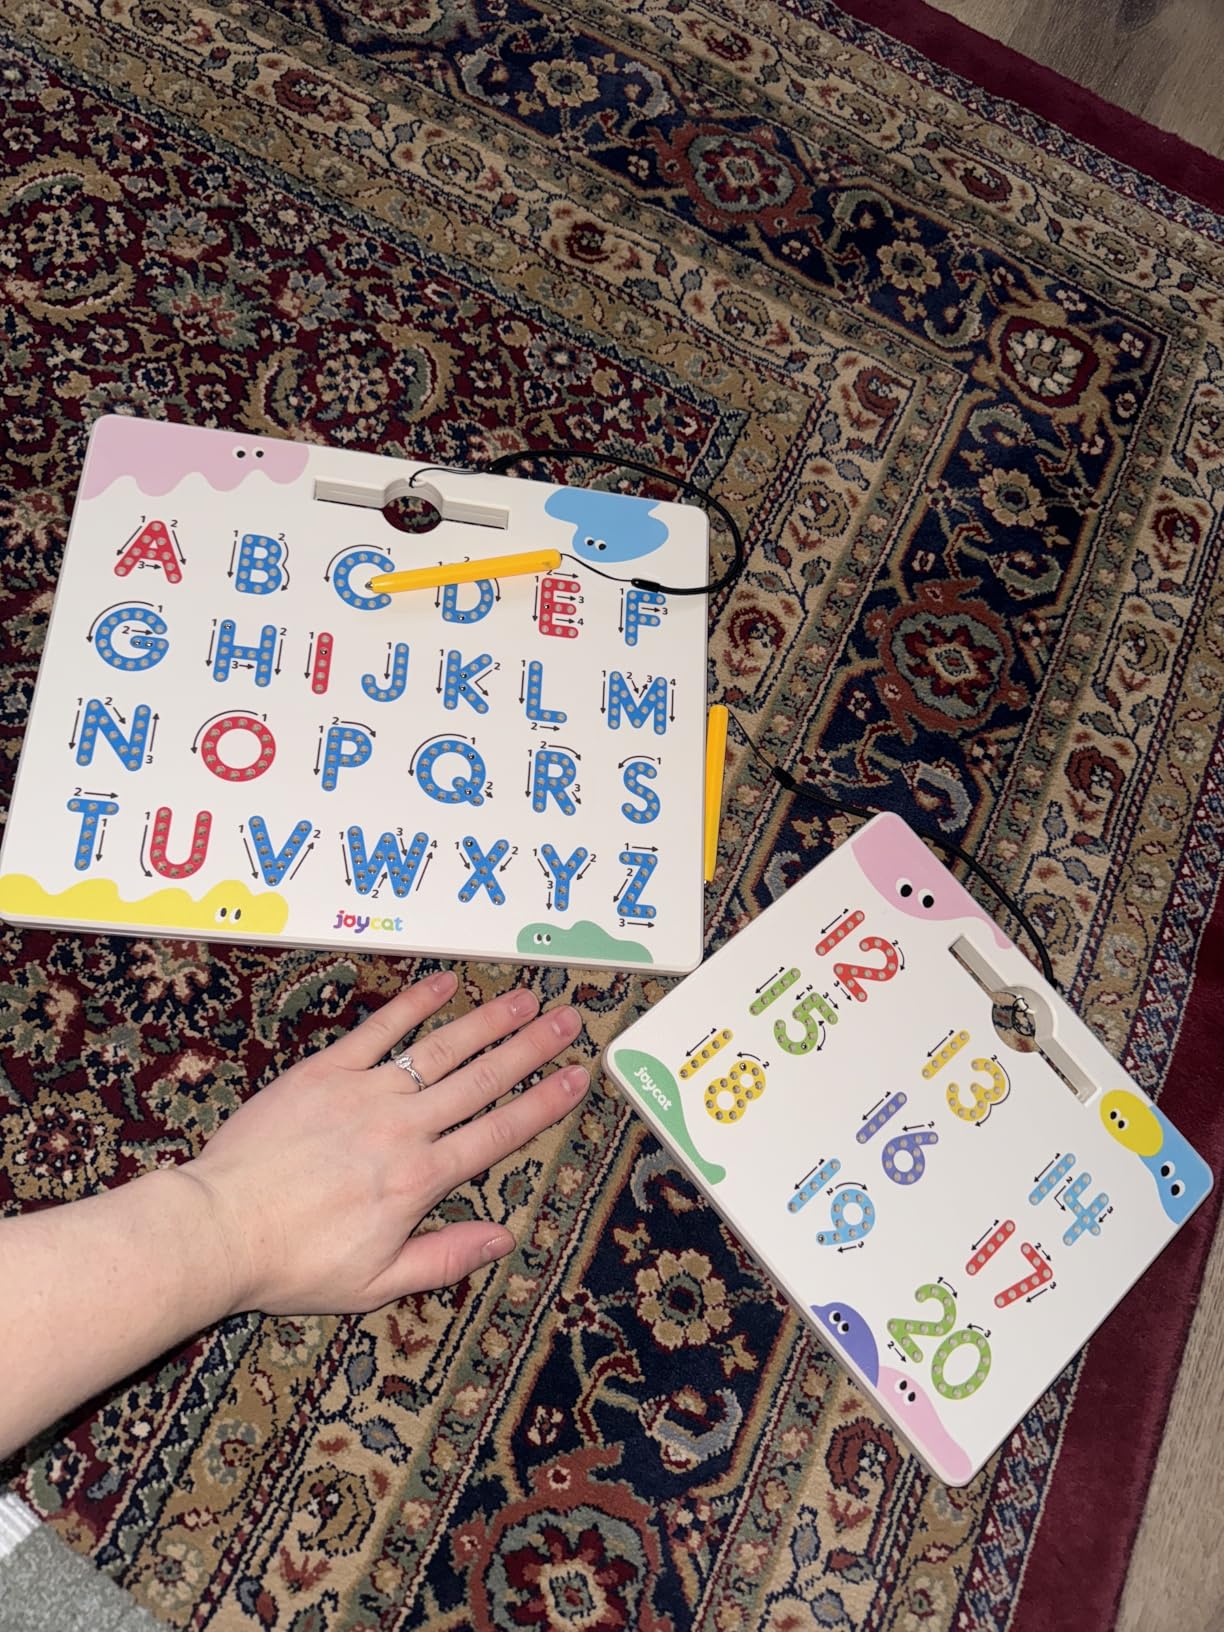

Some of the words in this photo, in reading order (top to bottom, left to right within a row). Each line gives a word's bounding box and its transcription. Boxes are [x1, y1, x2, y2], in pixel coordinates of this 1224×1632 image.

[115, 520, 183, 584] A
[235, 534, 283, 595] B
[333, 550, 396, 611] C
[442, 579, 494, 624] D
[538, 577, 581, 639] E
[625, 590, 666, 646] F
[95, 607, 169, 672] G
[213, 619, 277, 687] H
[311, 632, 334, 695] I
[361, 643, 410, 702] J
[443, 650, 494, 714] K
[525, 660, 568, 723] L
[607, 671, 668, 735] M
[76, 699, 152, 772] N
[201, 716, 276, 782] O
[321, 726, 373, 792] P
[416, 740, 487, 807] Q
[532, 750, 577, 816] R
[621, 761, 661, 824] S
[67, 798, 120, 871] T
[150, 807, 213, 880] U
[248, 815, 313, 887] V
[347, 825, 429, 898] W
[457, 836, 510, 906] X
[540, 843, 589, 912] Y
[616, 851, 658, 919] Z
[332, 909, 405, 935] joycat
[815, 910, 899, 1002] 12
[749, 967, 839, 1056] 15
[633, 1065, 673, 1111] joycat
[678, 1028, 767, 1125] 18
[921, 1029, 1006, 1122] 13
[855, 1091, 940, 1186] 16
[787, 1157, 877, 1247] 19
[1028, 1152, 1110, 1247] 14
[965, 1219, 1054, 1309] 17
[886, 1282, 992, 1401] 20
